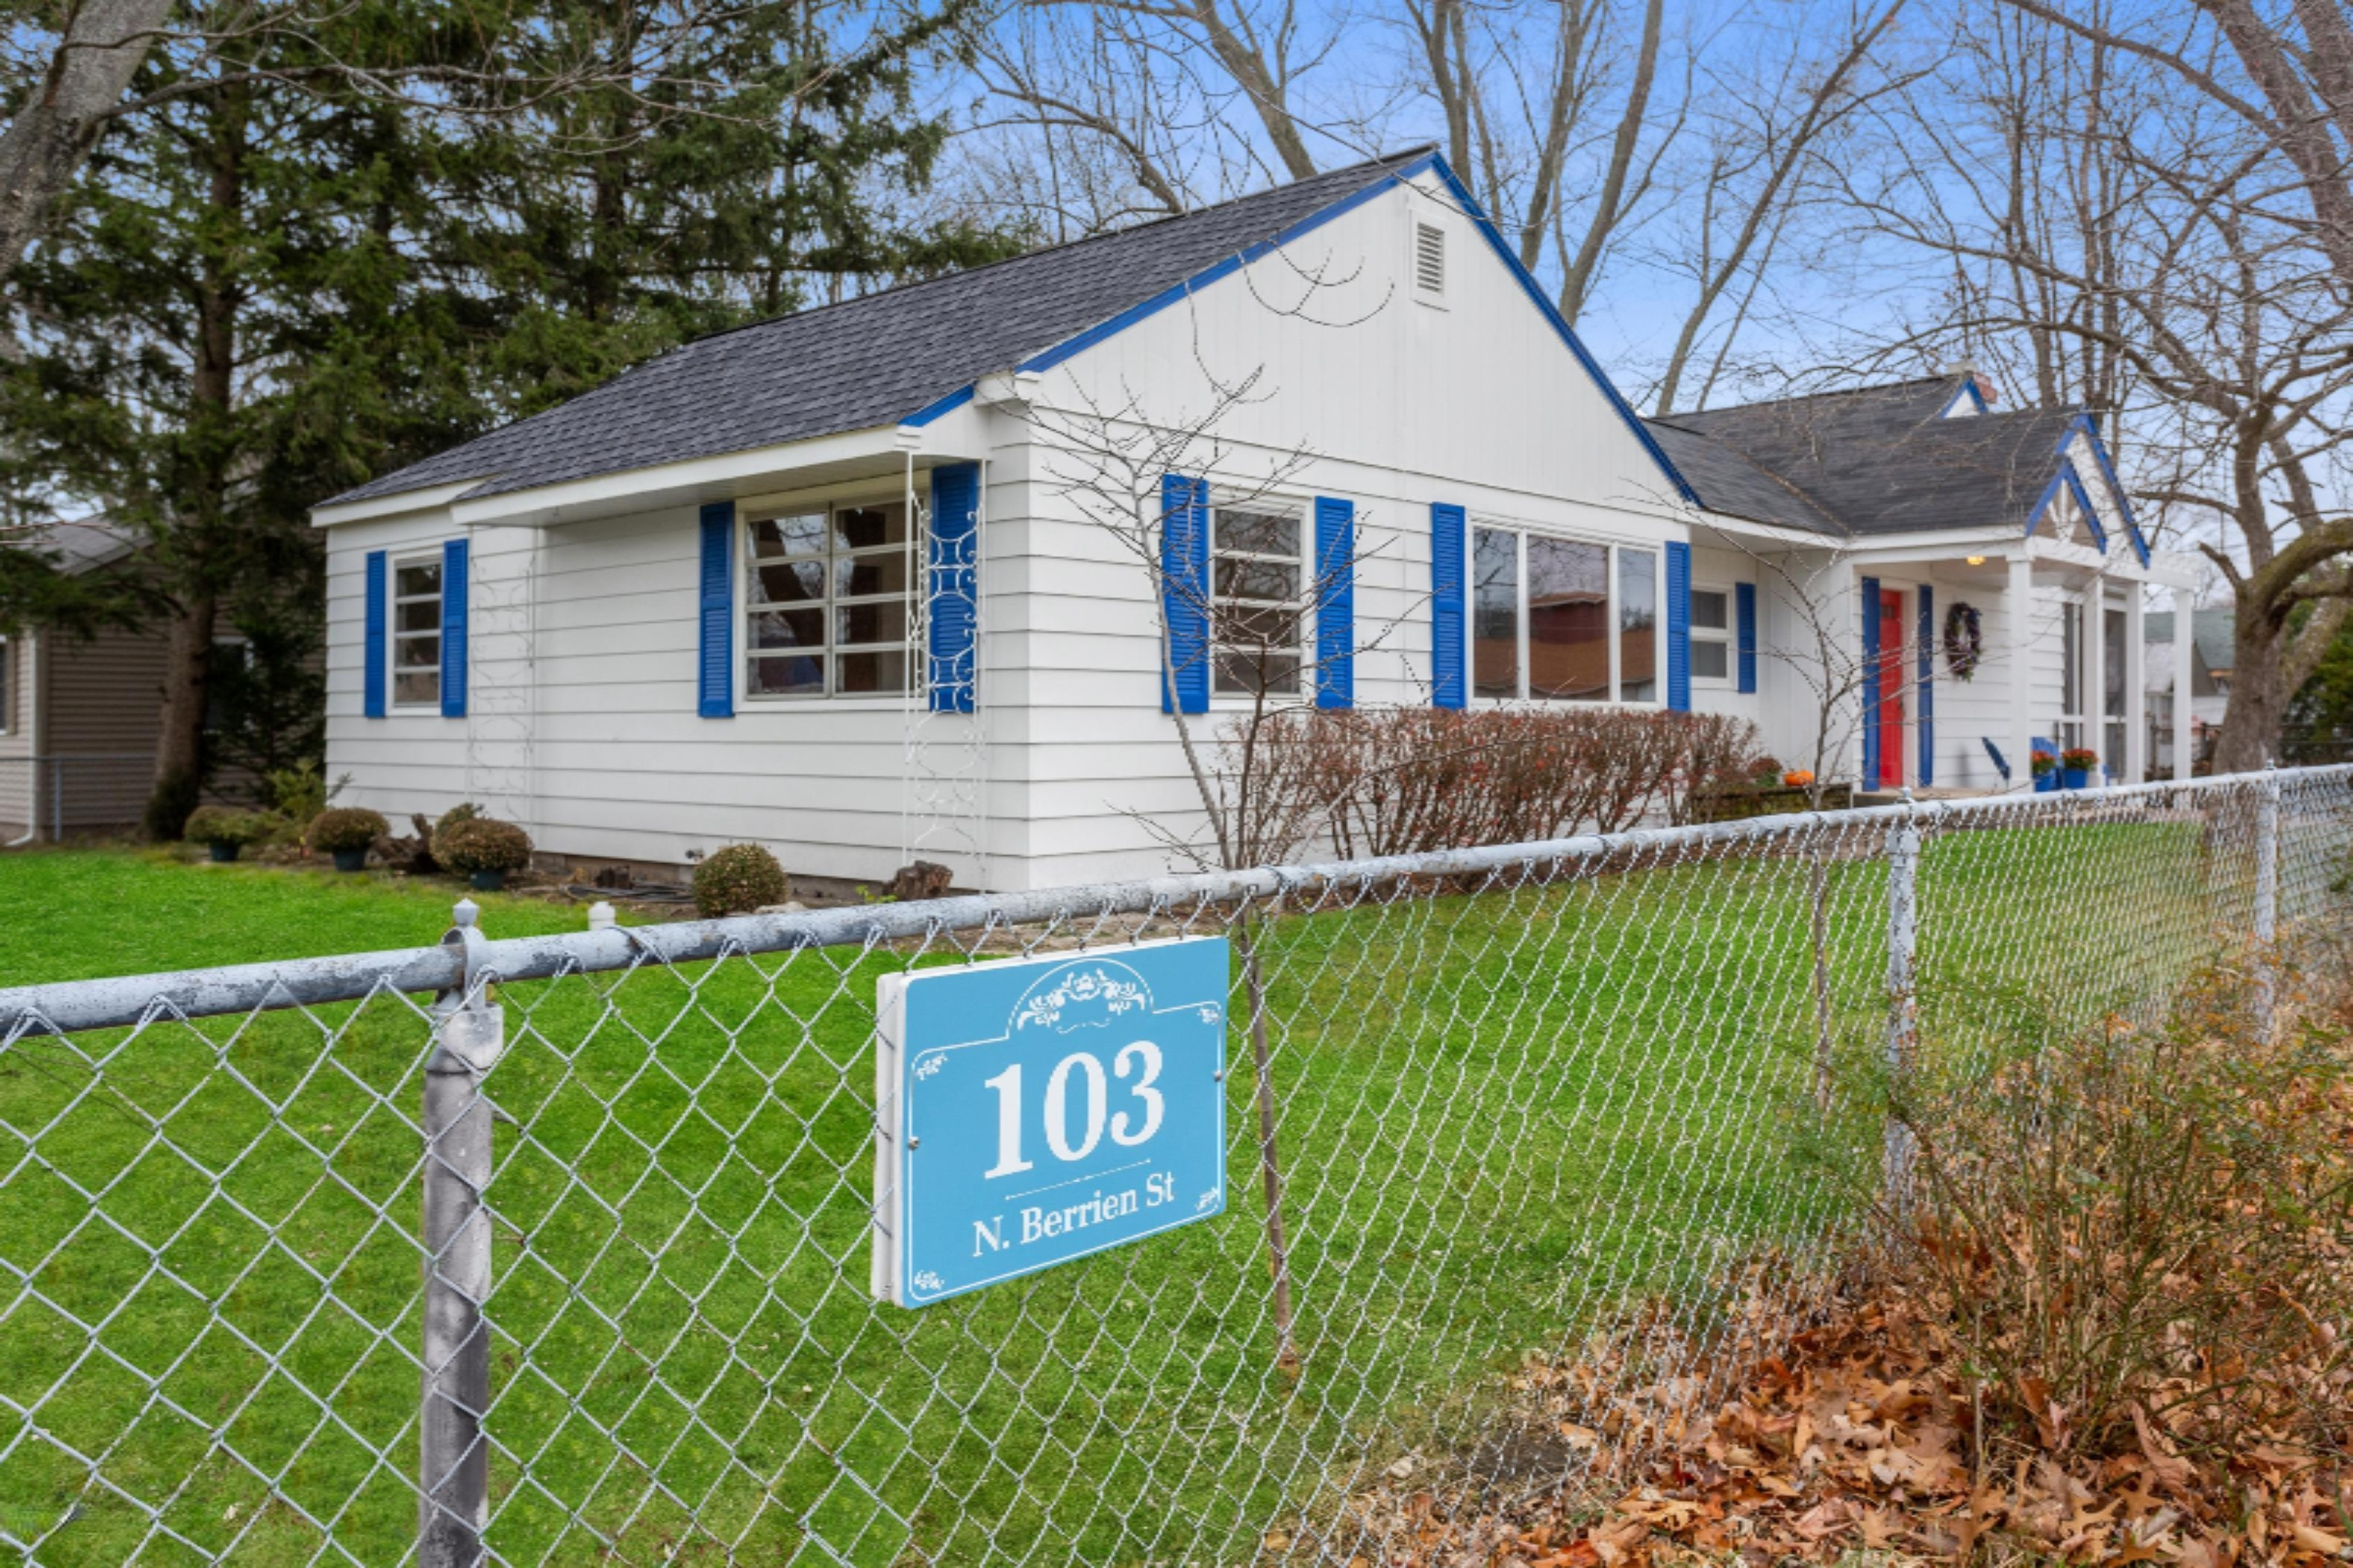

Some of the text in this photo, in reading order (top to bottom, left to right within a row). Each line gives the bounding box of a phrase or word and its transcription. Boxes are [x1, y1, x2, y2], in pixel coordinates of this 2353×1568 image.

[984, 1040, 1165, 1180] 103
[972, 1170, 1175, 1257] N. Berrien St
